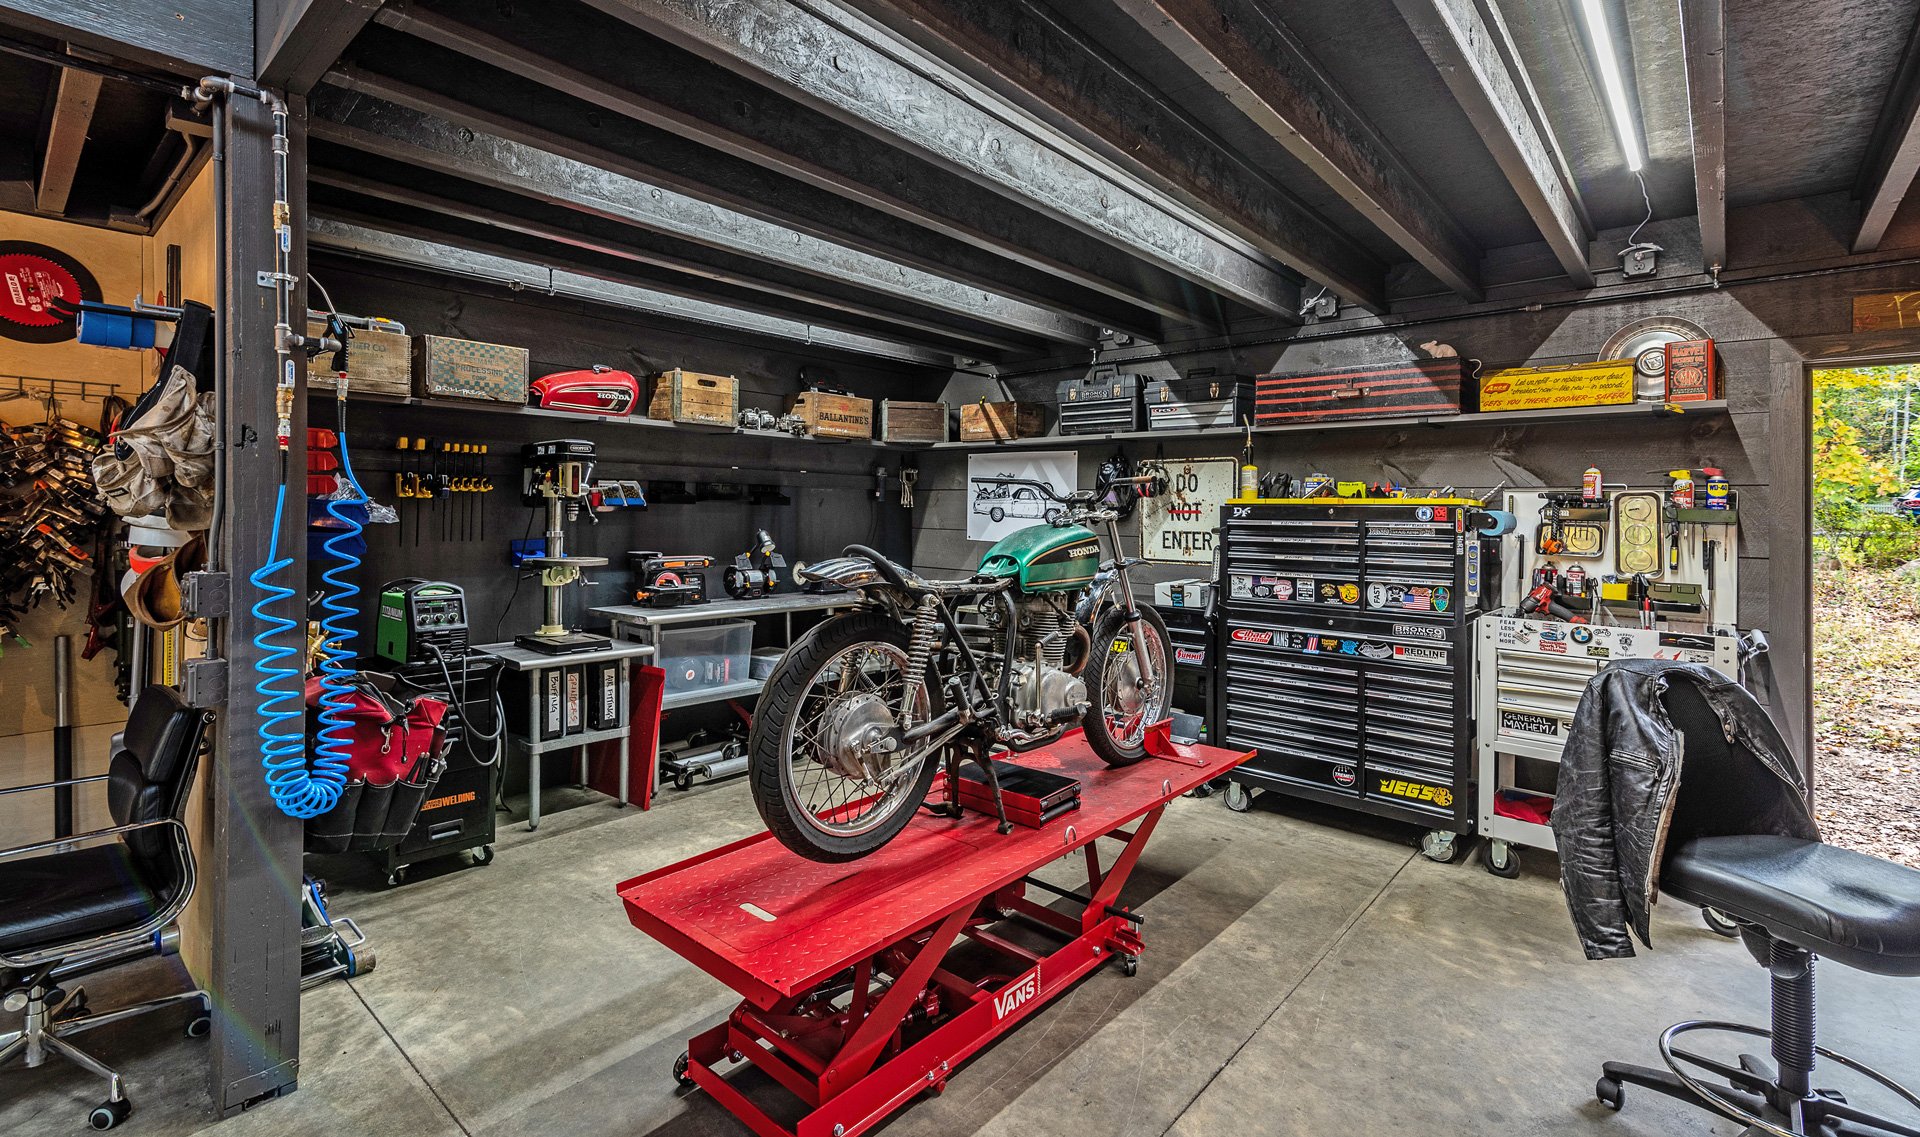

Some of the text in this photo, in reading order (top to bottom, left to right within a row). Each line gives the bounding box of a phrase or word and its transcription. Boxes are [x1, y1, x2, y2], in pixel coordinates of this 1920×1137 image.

[8, 275, 23, 304] DIABLO
[1672, 346, 1706, 357] MARVEL
[1606, 372, 1626, 380] dead
[597, 392, 631, 400] HONDA
[1525, 396, 1551, 404] THERE
[819, 412, 869, 425] BALLANTINE'S
[1176, 473, 1199, 493] DO
[1170, 502, 1202, 522] NOT
[1162, 531, 1213, 550] ENTER
[1068, 544, 1100, 558] HONDA
[382, 605, 404, 619] TITANIUM
[1233, 629, 1272, 641] Eibach
[1395, 625, 1442, 635] BRONCO
[1273, 631, 1289, 647] VANS
[1177, 648, 1205, 661] SUMMIT
[1404, 647, 1446, 658] REDLINE
[1504, 712, 1552, 726] GENERAL
[1503, 719, 1556, 736] MAYHEM!
[442, 791, 476, 807] WELDING
